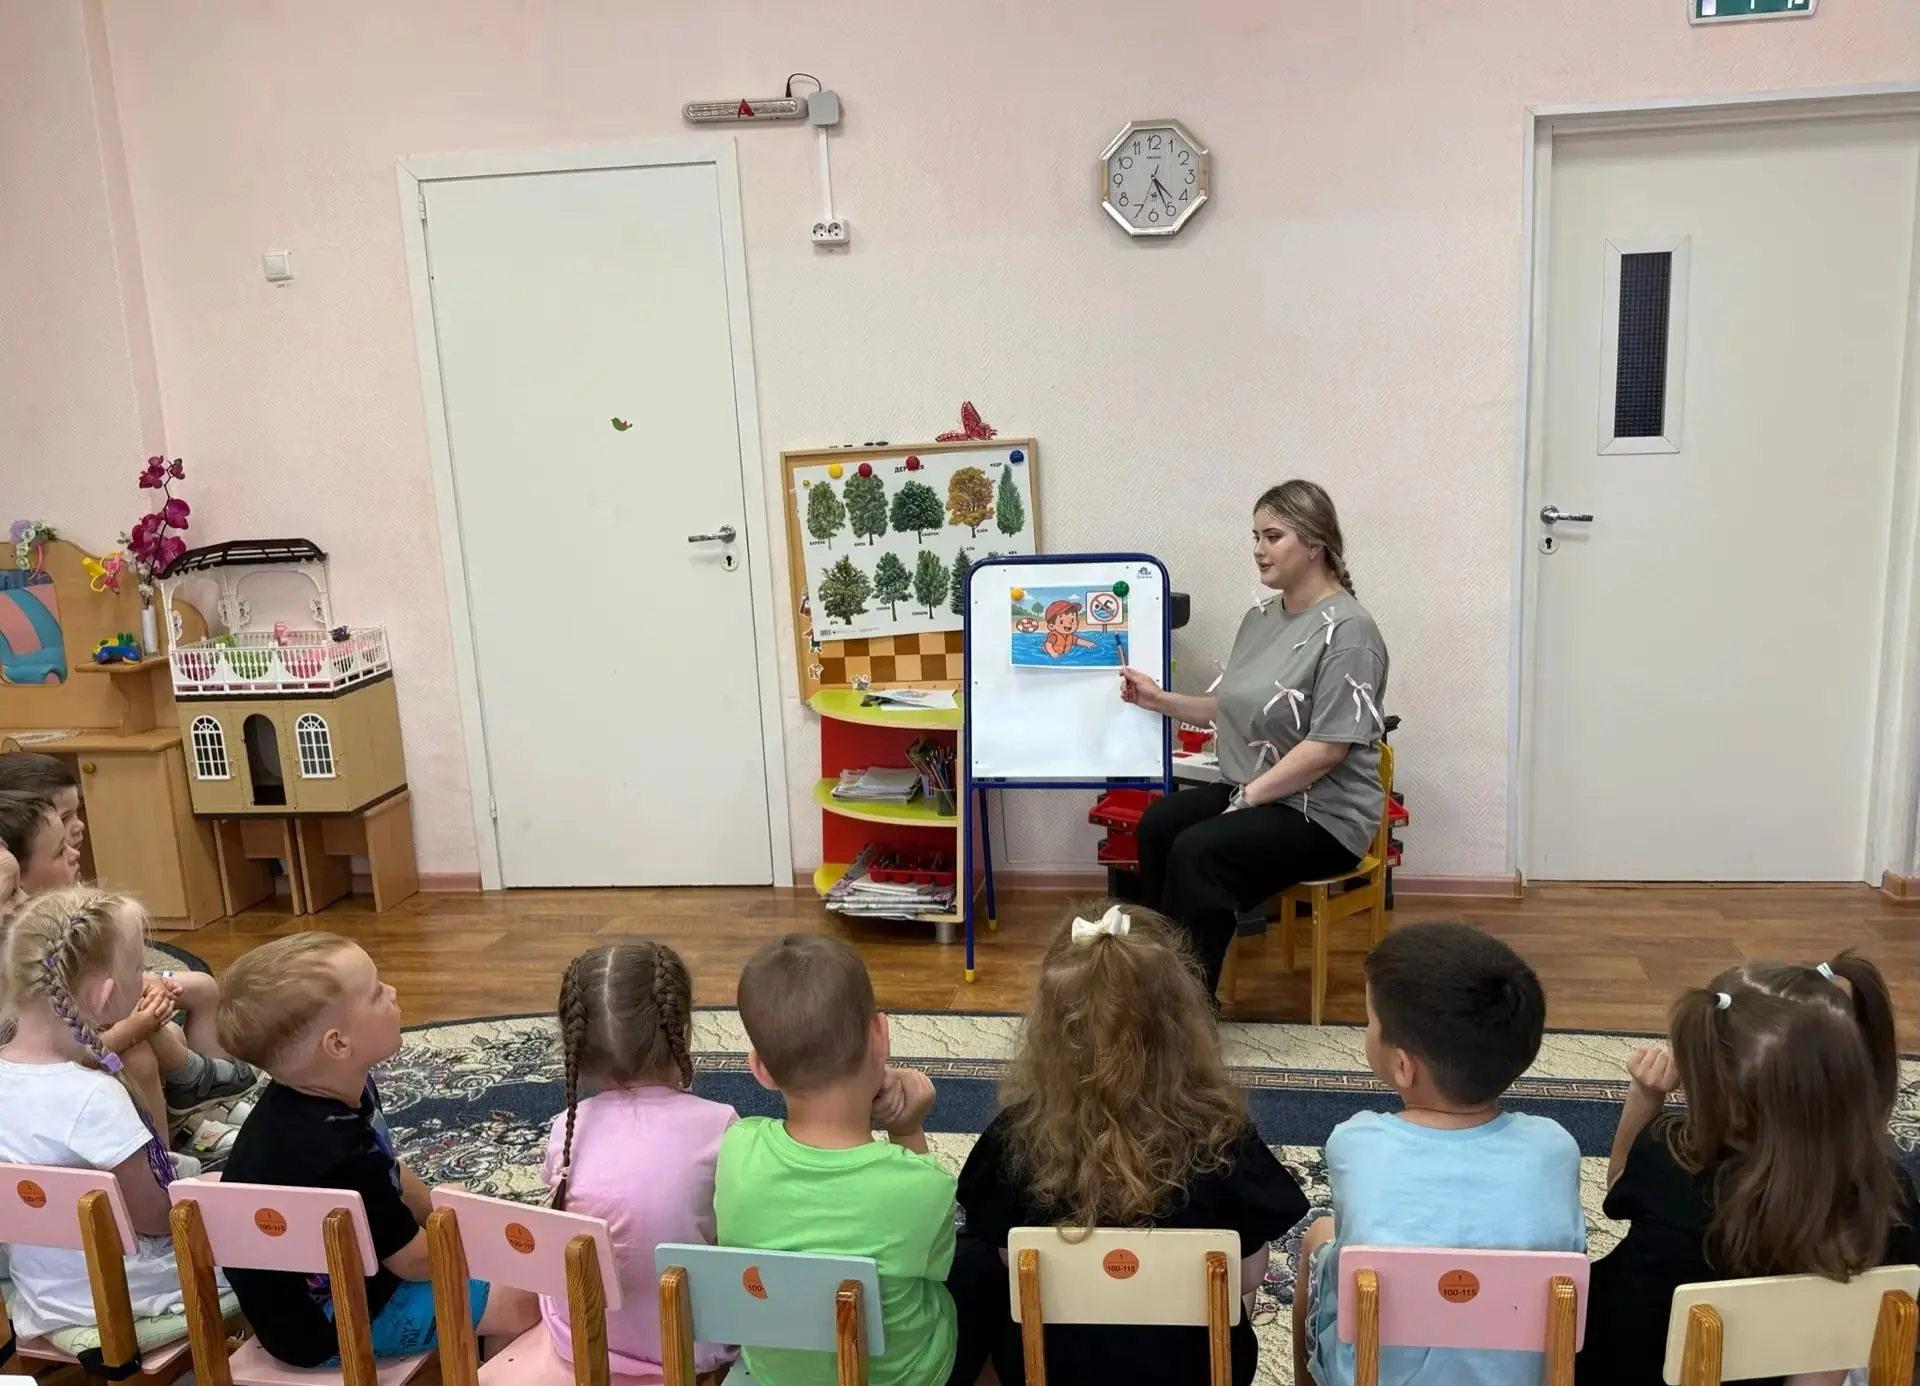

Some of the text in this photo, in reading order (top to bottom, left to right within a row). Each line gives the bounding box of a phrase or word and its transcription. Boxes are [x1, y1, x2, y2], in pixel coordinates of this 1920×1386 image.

[1132, 140, 1141, 155] 11
[1146, 134, 1162, 150] 12
[1168, 139, 1174, 153] 1
[1117, 156, 1133, 170] 10
[1177, 150, 1190, 165] 2
[1113, 173, 1123, 188] 9
[1184, 168, 1195, 184] 3
[1118, 192, 1129, 207] 8
[1178, 188, 1188, 202] 4
[1133, 203, 1144, 218] 7
[1148, 208, 1159, 222] 6
[1165, 201, 1177, 217] 5
[1107, 1265, 1136, 1273] 100-115
[1443, 1288, 1477, 1297] 100-115
